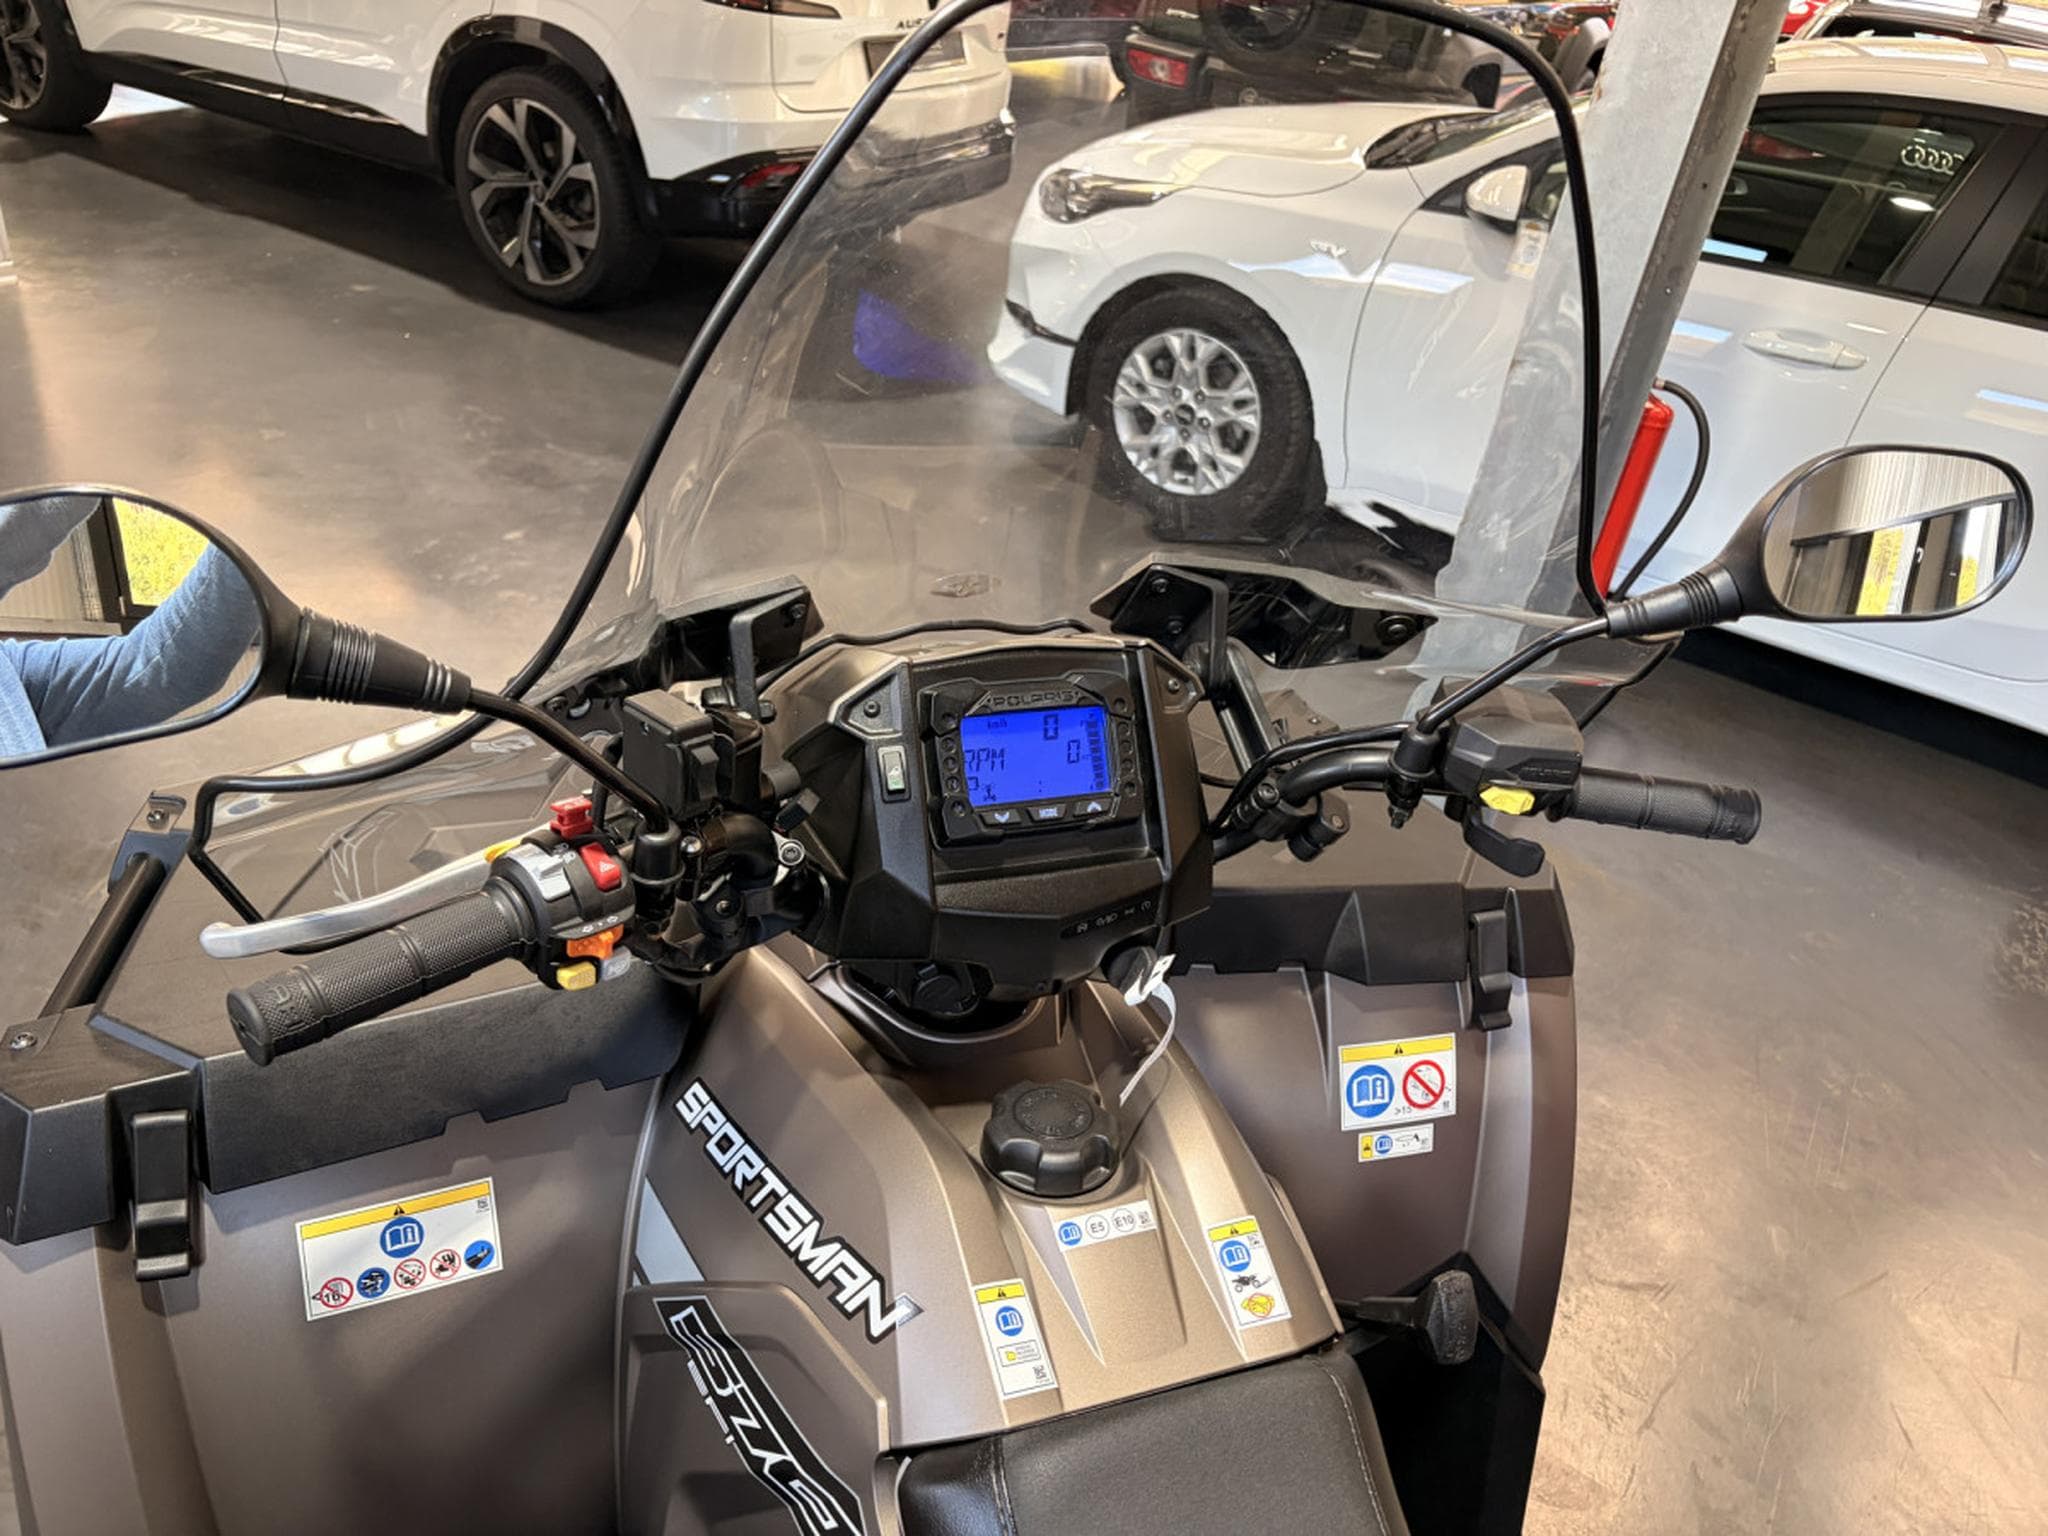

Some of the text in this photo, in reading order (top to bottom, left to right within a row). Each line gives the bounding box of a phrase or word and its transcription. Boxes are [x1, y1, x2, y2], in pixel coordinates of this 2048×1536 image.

[993, 690, 1074, 707] POLARIS
[1043, 714, 1059, 740] 0
[1067, 739, 1081, 764] 0
[674, 1080, 914, 1339] SPORTSMAN
[1090, 1214, 1135, 1234] E5 E10
